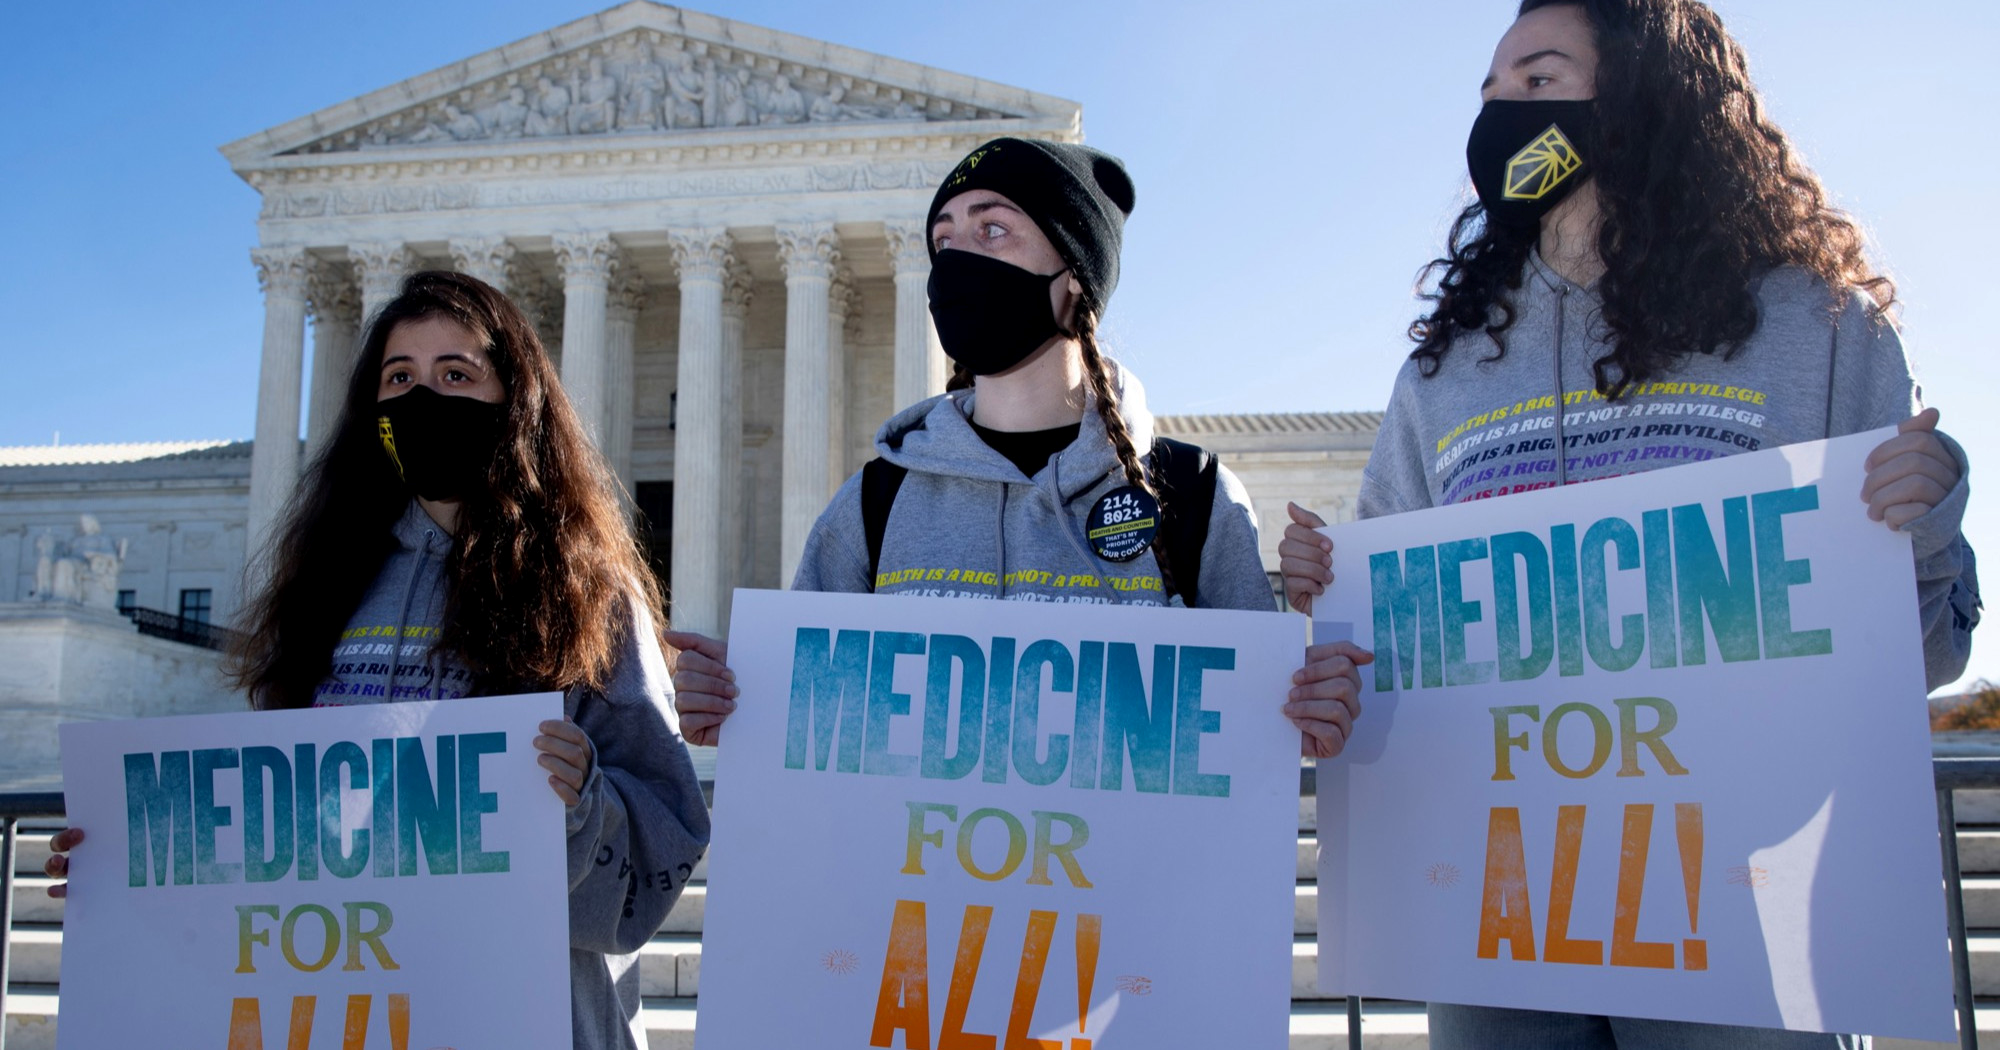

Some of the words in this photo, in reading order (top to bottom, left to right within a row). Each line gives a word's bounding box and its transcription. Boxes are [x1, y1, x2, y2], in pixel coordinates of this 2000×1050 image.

[576, 180, 657, 199] JUSTICE
[667, 175, 740, 194] UNDER
[748, 173, 792, 190] LAW
[1490, 406, 1510, 422] IS
[1510, 402, 1523, 416] A
[1648, 382, 1767, 405] PRIVILEGE
[1435, 431, 1485, 474] HEALTH
[1485, 425, 1505, 442] IS
[1505, 422, 1520, 437] A
[1585, 404, 1629, 425] NOT
[1628, 403, 1644, 418] A
[1645, 402, 1766, 429] PRIVILEGE
[1481, 446, 1501, 463] IS
[1501, 443, 1516, 457] A
[1583, 427, 1626, 446] NOT
[1625, 425, 1642, 440] A
[1642, 423, 1761, 451] PRIVILEGE
[1475, 467, 1496, 483] IS
[1496, 463, 1512, 478] A
[1581, 449, 1624, 470] NOT
[1623, 447, 1639, 463] A
[1103, 493, 1140, 511] 214,
[1103, 507, 1143, 525] 802+
[1105, 532, 1127, 542] THAT'S
[1128, 531, 1138, 539] MY
[1111, 524, 1123, 533] AND
[1123, 519, 1152, 531] COUNTING
[925, 568, 946, 581] IS
[945, 568, 960, 581] A
[1016, 569, 1053, 585] NOT
[1053, 574, 1067, 588] A
[1368, 484, 1833, 693] MEDICINE
[336, 662, 355, 675] IS
[354, 662, 368, 675] A
[344, 643, 362, 656] IS
[361, 643, 374, 655] A
[331, 682, 348, 695] IS
[349, 682, 361, 695] A
[785, 627, 1236, 798] MEDICINE
[1488, 697, 1690, 781] FOR
[123, 732, 510, 888] MEDICINE
[900, 801, 1093, 889] FOR
[1477, 803, 1708, 971] ALL!
[234, 900, 401, 975] FOR
[869, 898, 1102, 1050] ALL!
